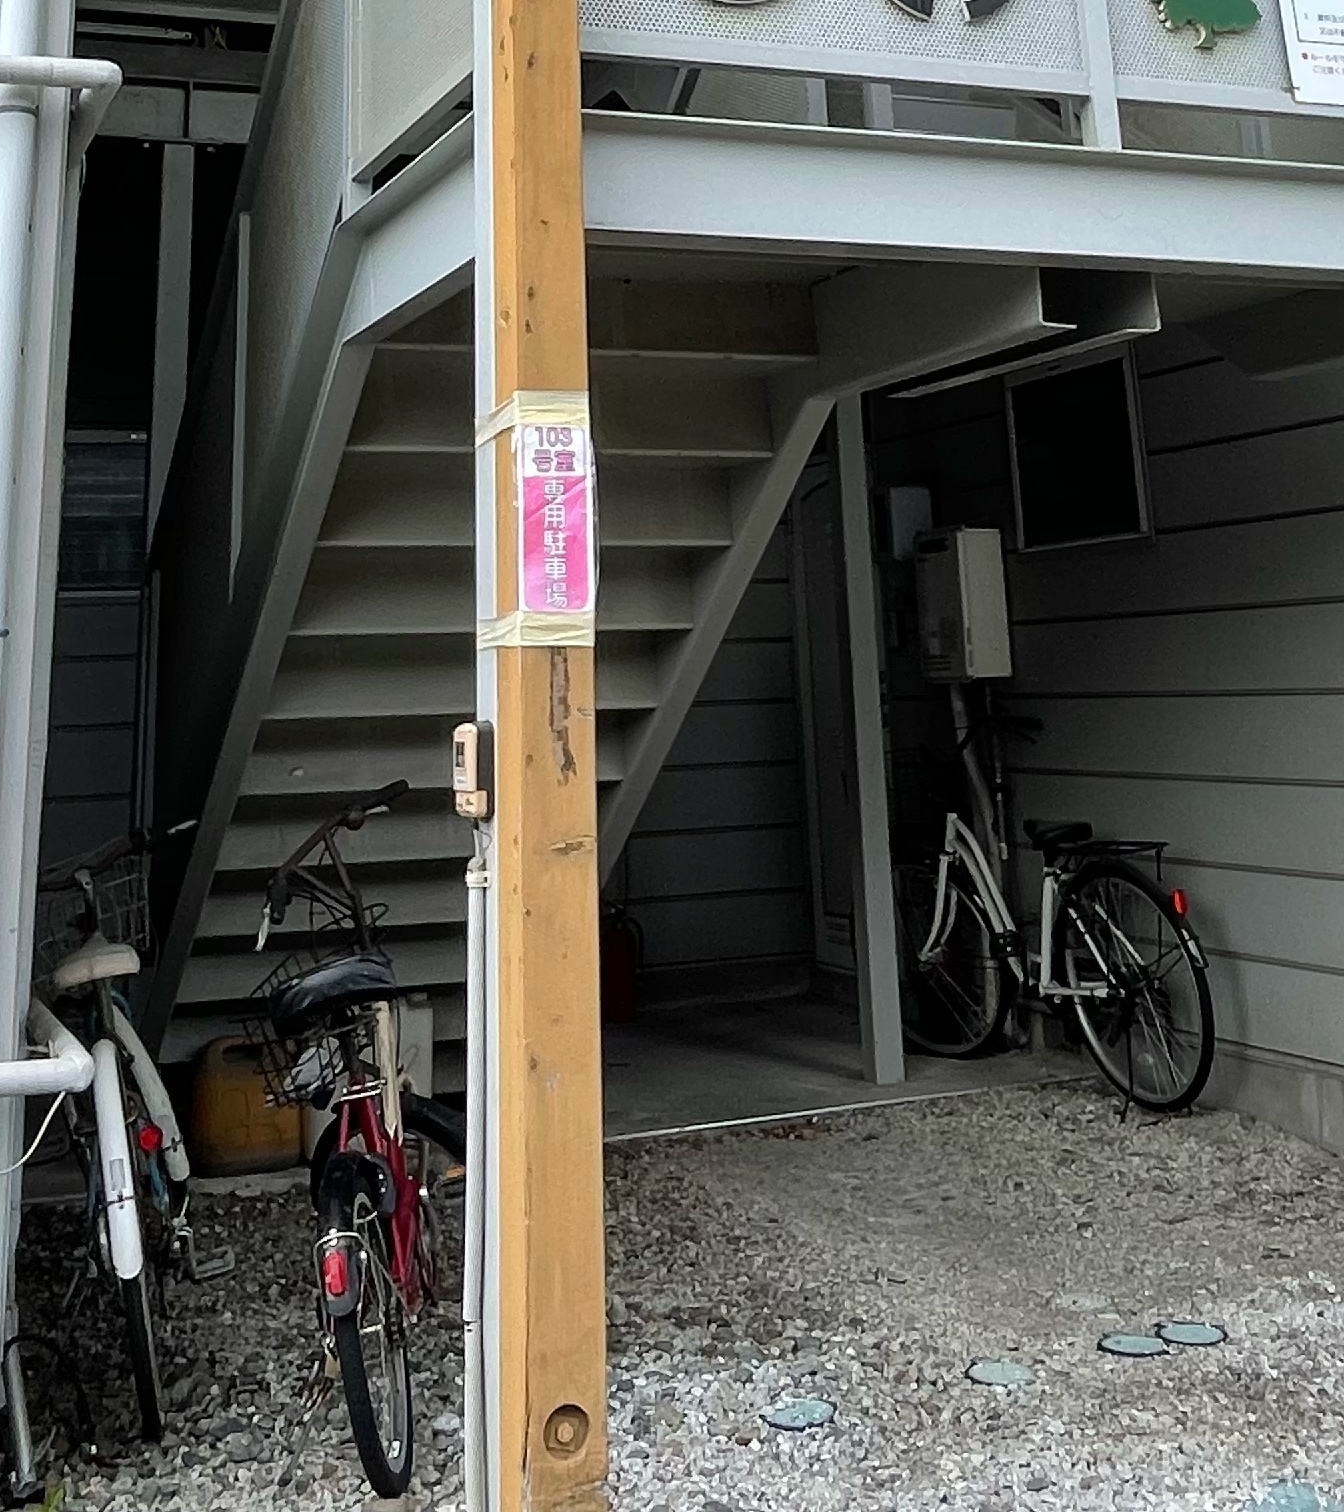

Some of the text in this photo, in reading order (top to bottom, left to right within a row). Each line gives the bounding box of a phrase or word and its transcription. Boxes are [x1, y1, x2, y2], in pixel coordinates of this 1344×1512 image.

[534, 426, 573, 447] 103
[532, 448, 576, 473] 号室
[542, 478, 569, 609] 専用駐車場
